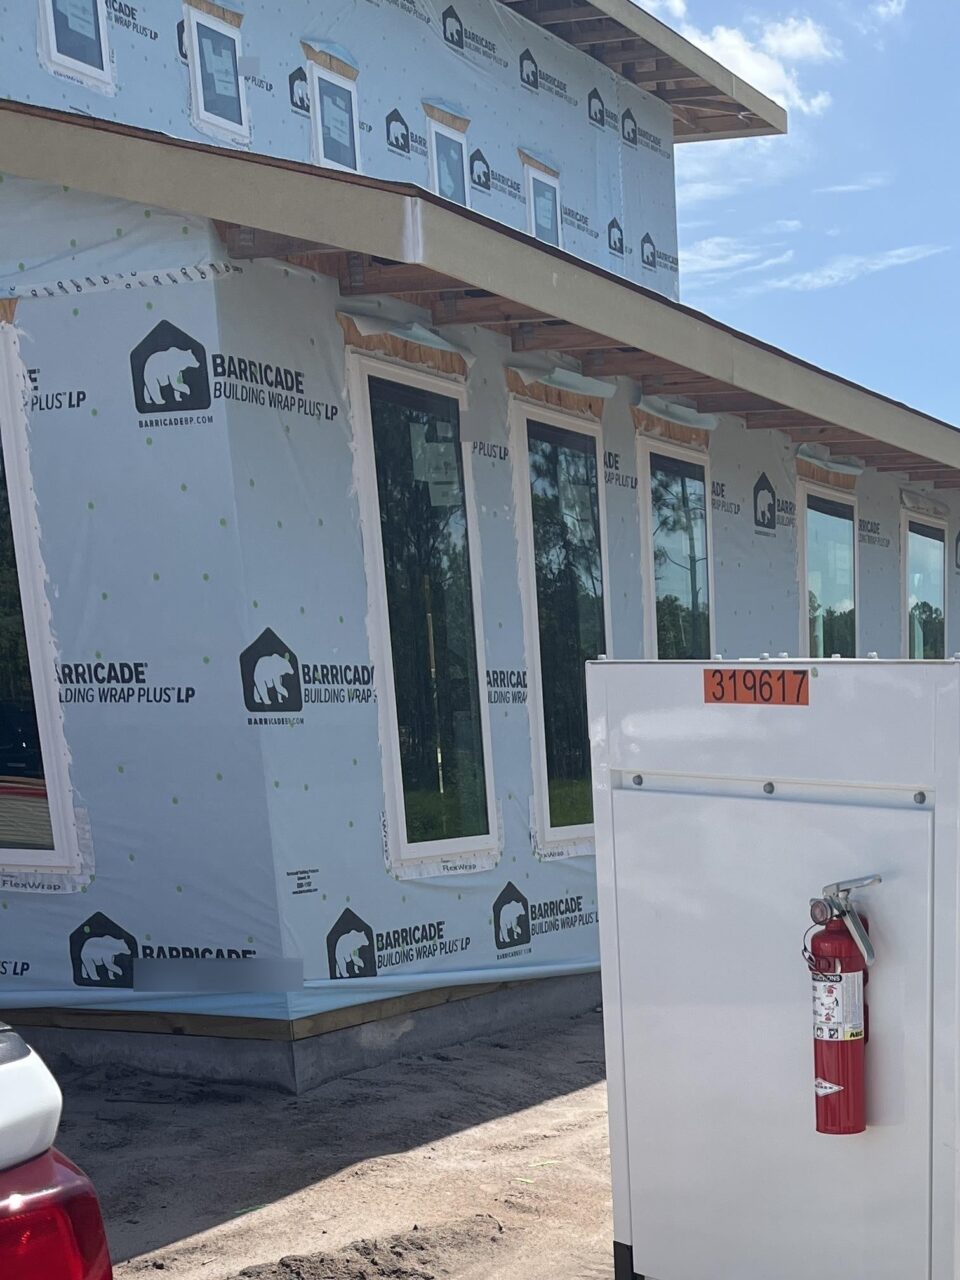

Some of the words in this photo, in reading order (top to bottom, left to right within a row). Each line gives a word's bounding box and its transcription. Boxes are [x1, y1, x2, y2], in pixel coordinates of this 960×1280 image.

[150, 30, 158, 40] LP
[212, 354, 304, 394] BARRICADE
[68, 391, 86, 409] LP
[214, 382, 265, 406] BUILDING
[268, 391, 295, 412] WRAP
[325, 404, 338, 421] LP
[498, 446, 509, 461] LP
[57, 662, 146, 684] RRICADE
[59, 687, 94, 703] LDING
[98, 687, 135, 703] WRAP
[177, 687, 195, 703] LP
[304, 688, 346, 703] BUILDING
[347, 688, 372, 703] WRAP
[712, 669, 808, 703] 319617
[512, 691, 527, 704] WRA
[2, 879, 61, 891] FlexWrap
[530, 896, 583, 921] BARRICADE
[531, 919, 559, 936] BUILDING
[560, 914, 577, 929] WRAP
[376, 921, 445, 952] BARRICADE
[377, 947, 413, 969] BUILDING
[415, 943, 438, 960] WRAP
[460, 937, 471, 951] LP
[12, 962, 30, 976] LP
